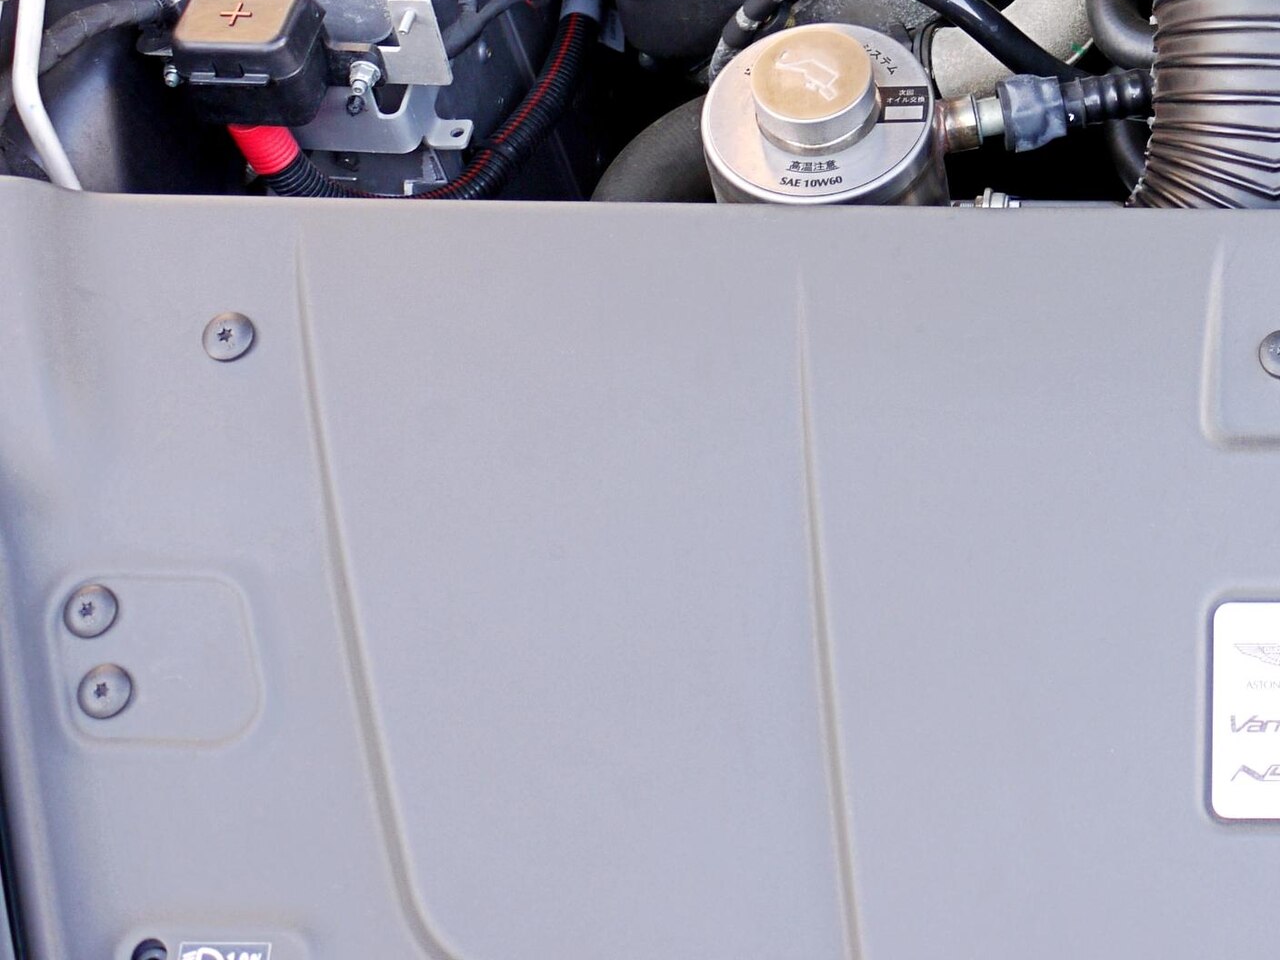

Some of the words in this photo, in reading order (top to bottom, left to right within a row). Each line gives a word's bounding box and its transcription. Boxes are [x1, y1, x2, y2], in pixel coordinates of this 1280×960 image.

[886, 96, 925, 104] オイル交換
[790, 159, 837, 172] 高温注意
[779, 176, 802, 188] SAE
[803, 175, 843, 188] 10W60
